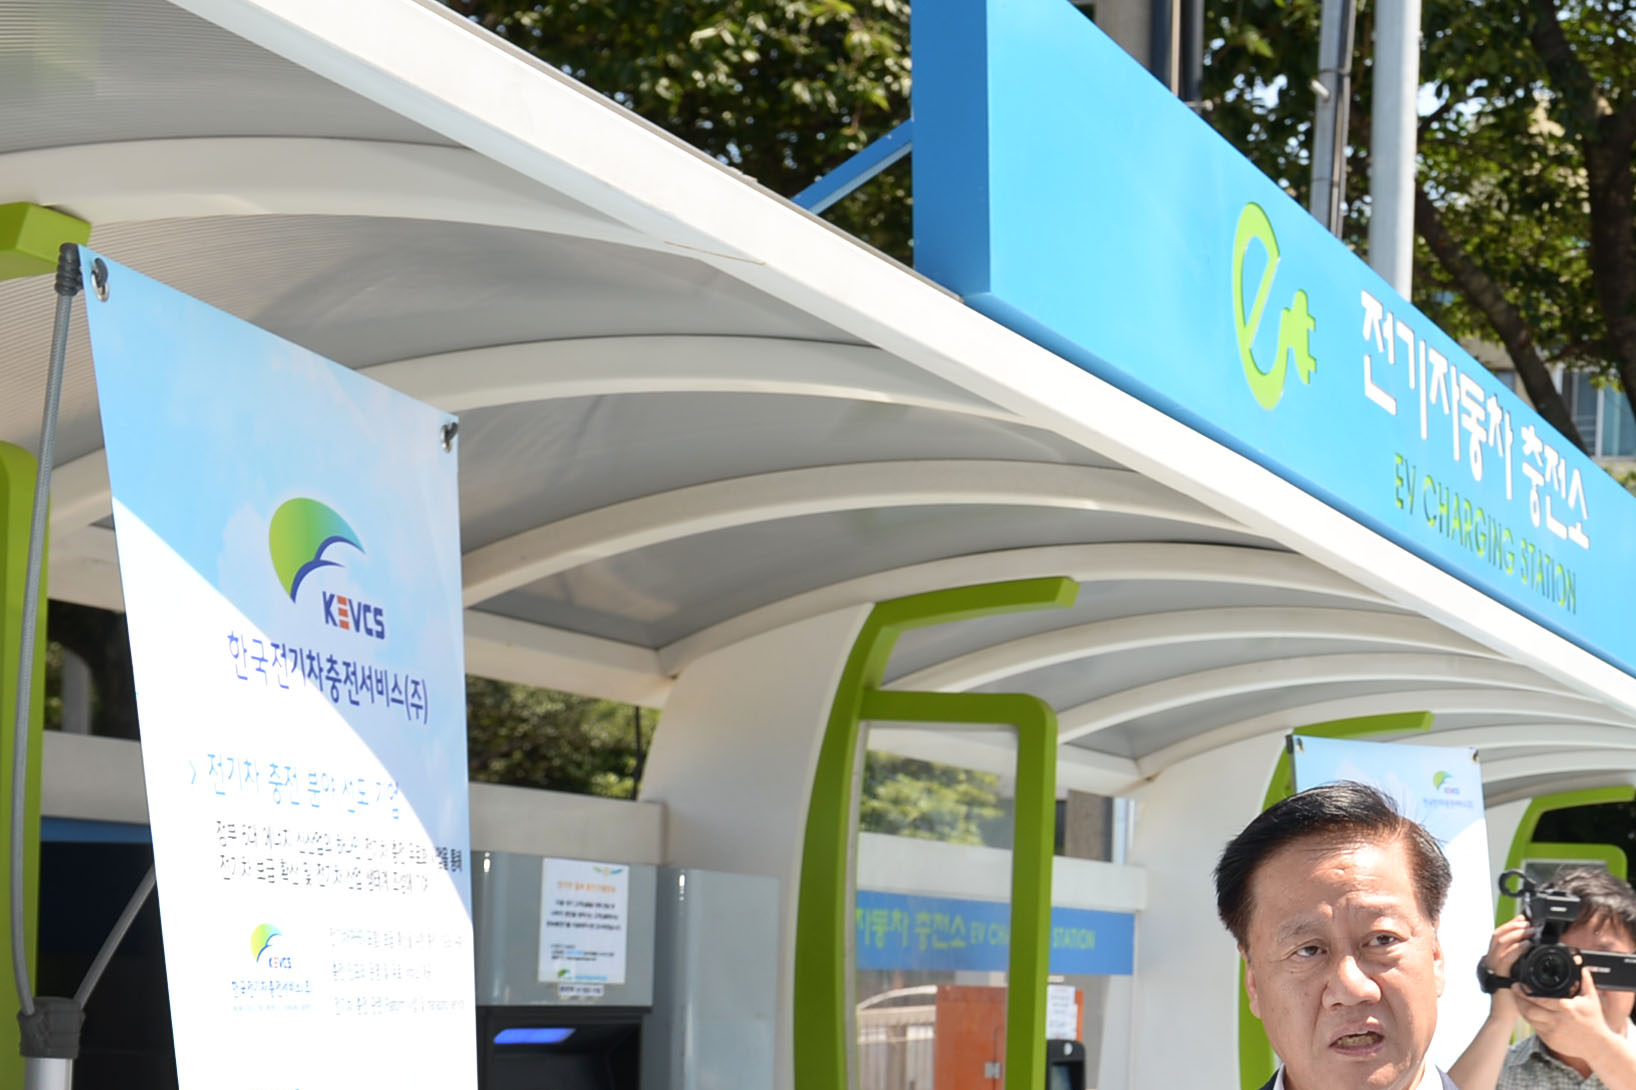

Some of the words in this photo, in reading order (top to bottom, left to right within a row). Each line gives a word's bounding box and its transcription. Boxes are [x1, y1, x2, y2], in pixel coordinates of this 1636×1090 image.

[1360, 289, 1514, 501] 전기자동차
[1521, 424, 1590, 550] 충전소
[1394, 453, 1416, 513] EV
[1423, 474, 1515, 576] CHARGING
[1520, 537, 1577, 615] STATION
[322, 590, 386, 640] KEVCS
[226, 629, 429, 726] 한국전기차충전서비스(주)
[914, 910, 967, 951] 충전소
[1052, 926, 1097, 951] STATION
